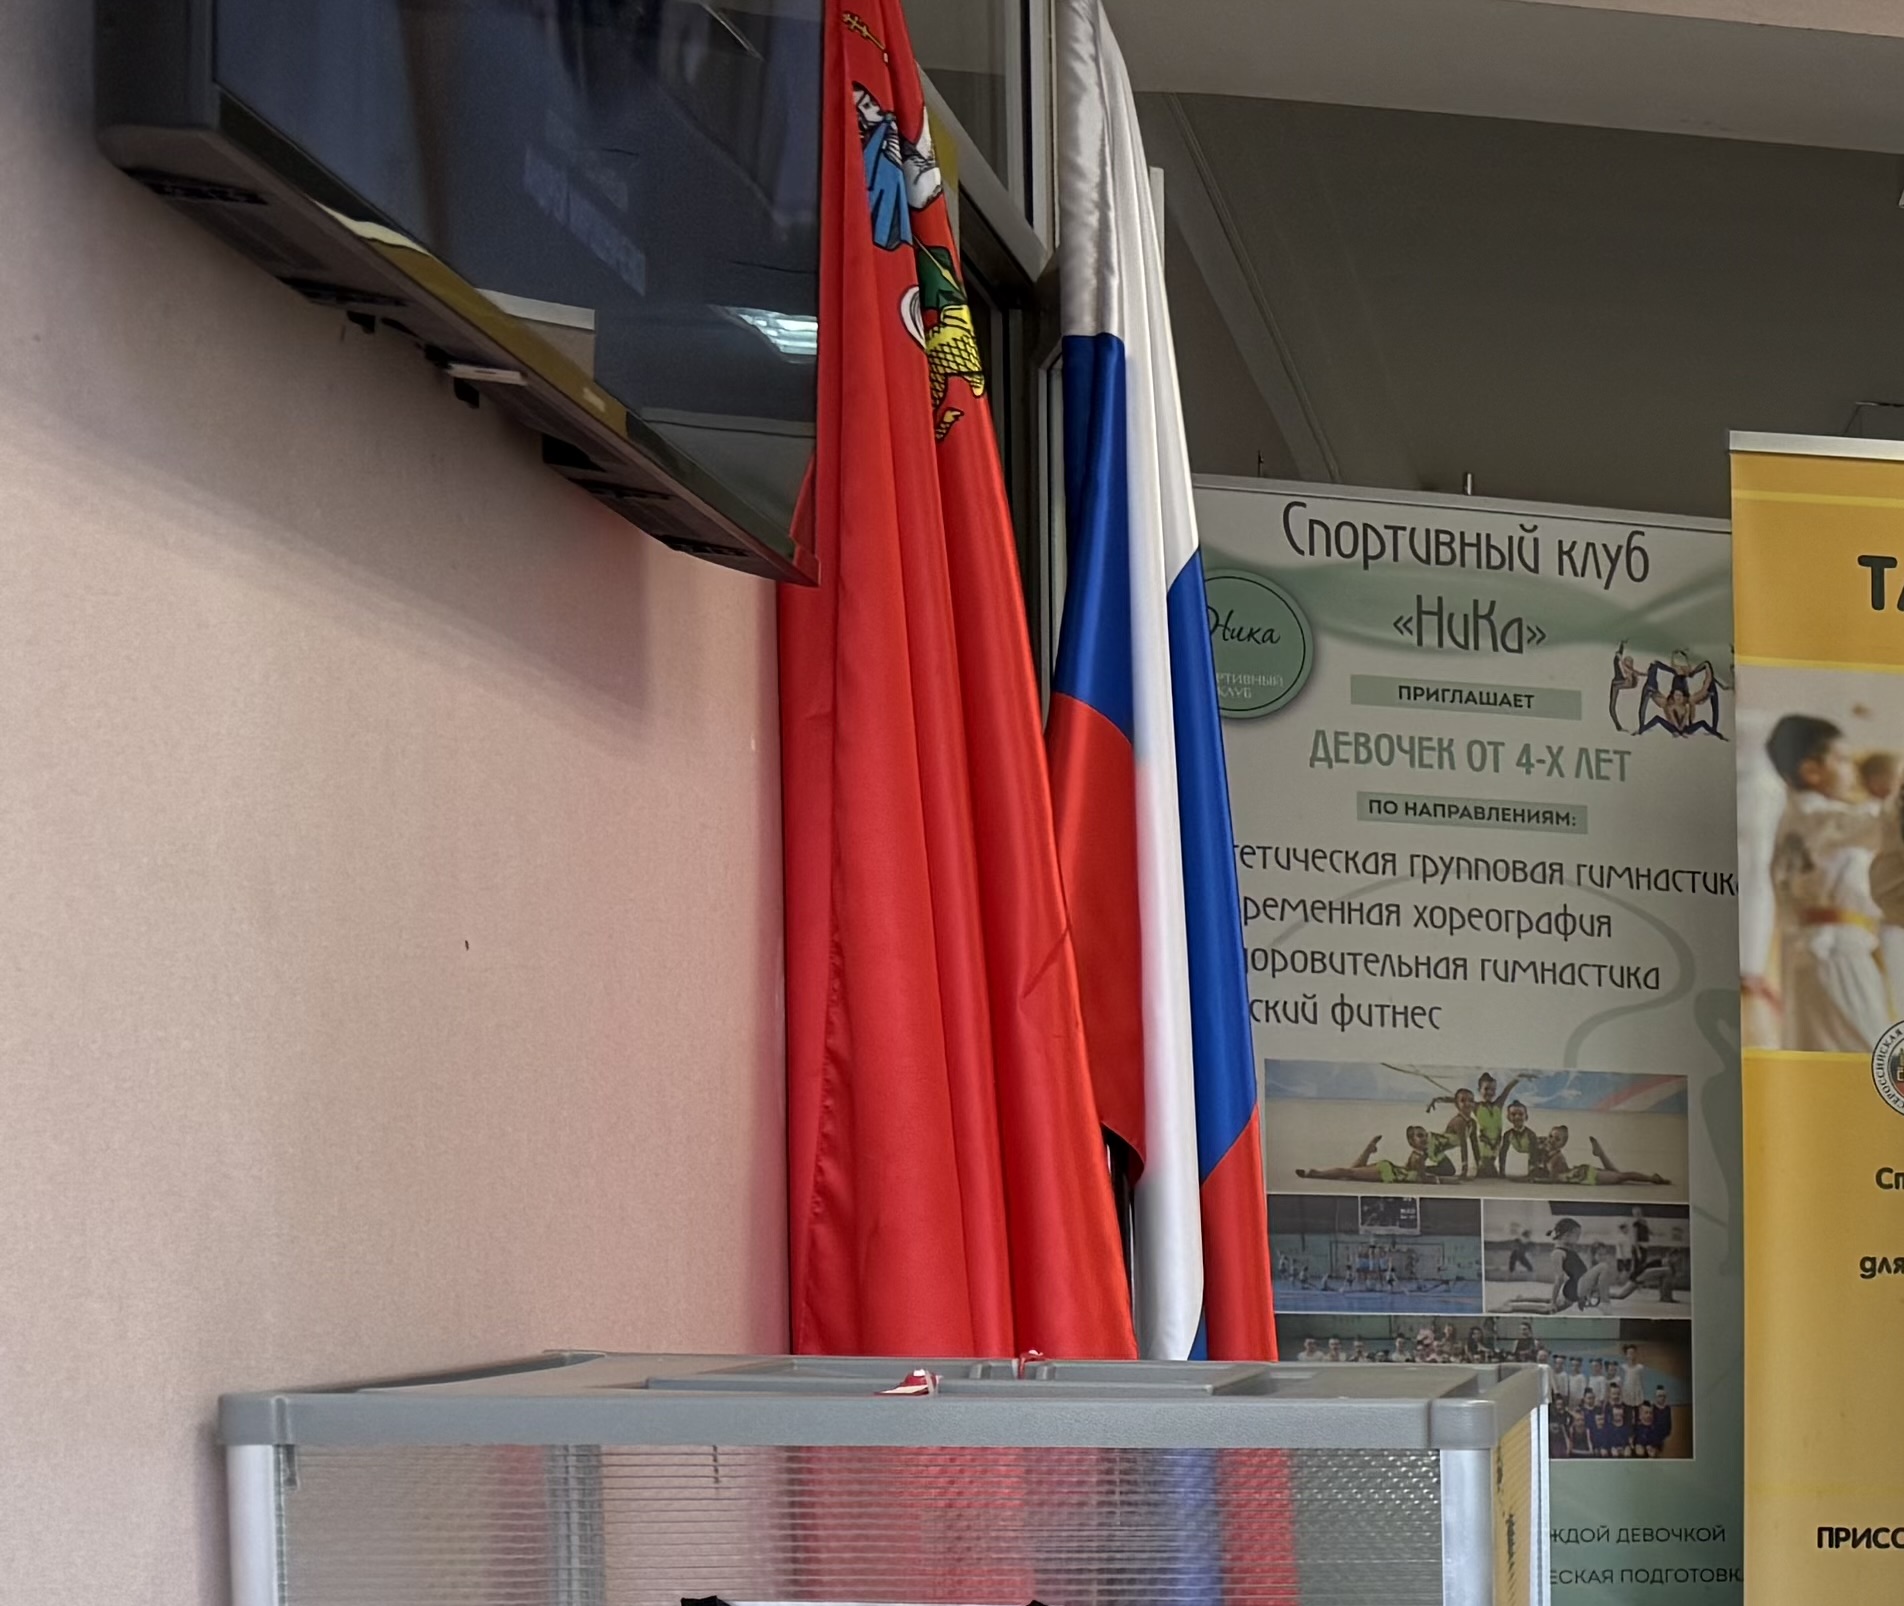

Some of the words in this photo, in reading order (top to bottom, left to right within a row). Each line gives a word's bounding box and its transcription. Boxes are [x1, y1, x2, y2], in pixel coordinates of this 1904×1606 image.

[1282, 501, 1540, 574] Спортивный
[1557, 530, 1650, 590] клуб
[1216, 673, 1284, 687] РТИВНЫЙ
[1398, 685, 1534, 709] ПРИГЛАШАЕТ
[1309, 729, 1456, 771] ДЕВОЧЕК
[1467, 740, 1505, 773] ОТ
[1516, 743, 1565, 778] 4-Х
[1574, 746, 1632, 782] ЛЕТ
[1368, 799, 1399, 815] ПО
[1404, 802, 1577, 827] НАПРАВЛЕНИЯМ:
[1233, 844, 1397, 877] етическая
[1409, 854, 1564, 886] групповая
[1576, 864, 1739, 896] гимнастик
[1243, 896, 1401, 927] ременная
[1412, 903, 1612, 942] хореография
[1244, 947, 1468, 981] оровительная
[1480, 958, 1660, 990] гимнастика
[1250, 993, 1318, 1025] ский
[1331, 993, 1442, 1032] фитнес
[1550, 1525, 1610, 1543] ЖДОЙ
[1616, 1525, 1726, 1543] ДЕВОЧКОЙ
[1550, 1569, 1614, 1584] ЕСКАЯ
[1621, 1568, 1744, 1584] ПОДГОТОВК
